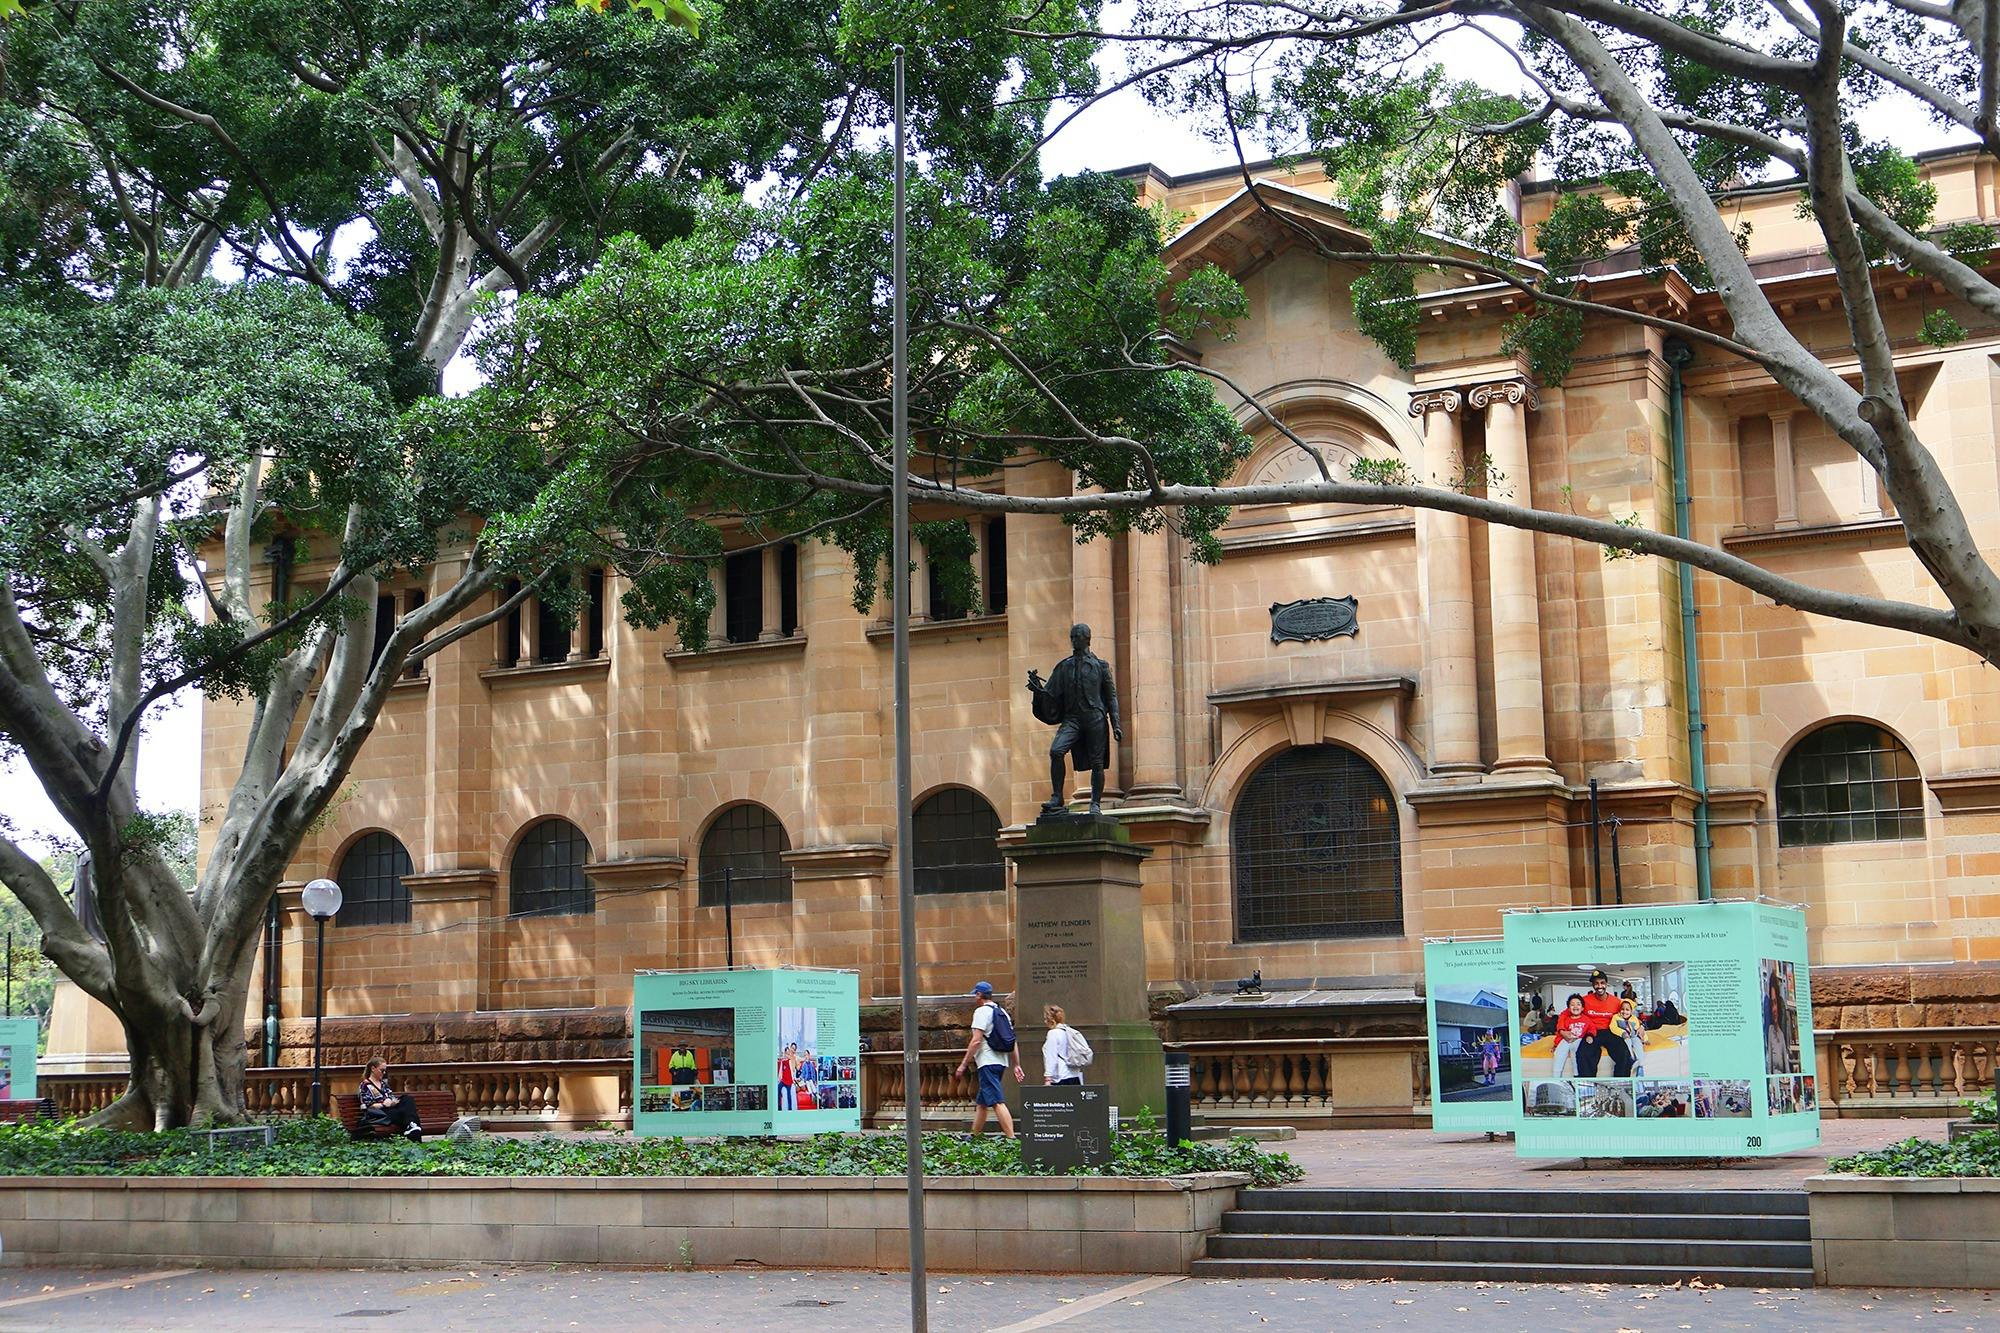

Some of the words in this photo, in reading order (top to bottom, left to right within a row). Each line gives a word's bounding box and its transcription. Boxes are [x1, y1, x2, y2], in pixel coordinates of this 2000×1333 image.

[1568, 919, 1620, 928] LIVERPOOL
[1621, 918, 1643, 927] CITY
[1646, 917, 1686, 926] LIBRARY
[1747, 1136, 1762, 1147] 200
